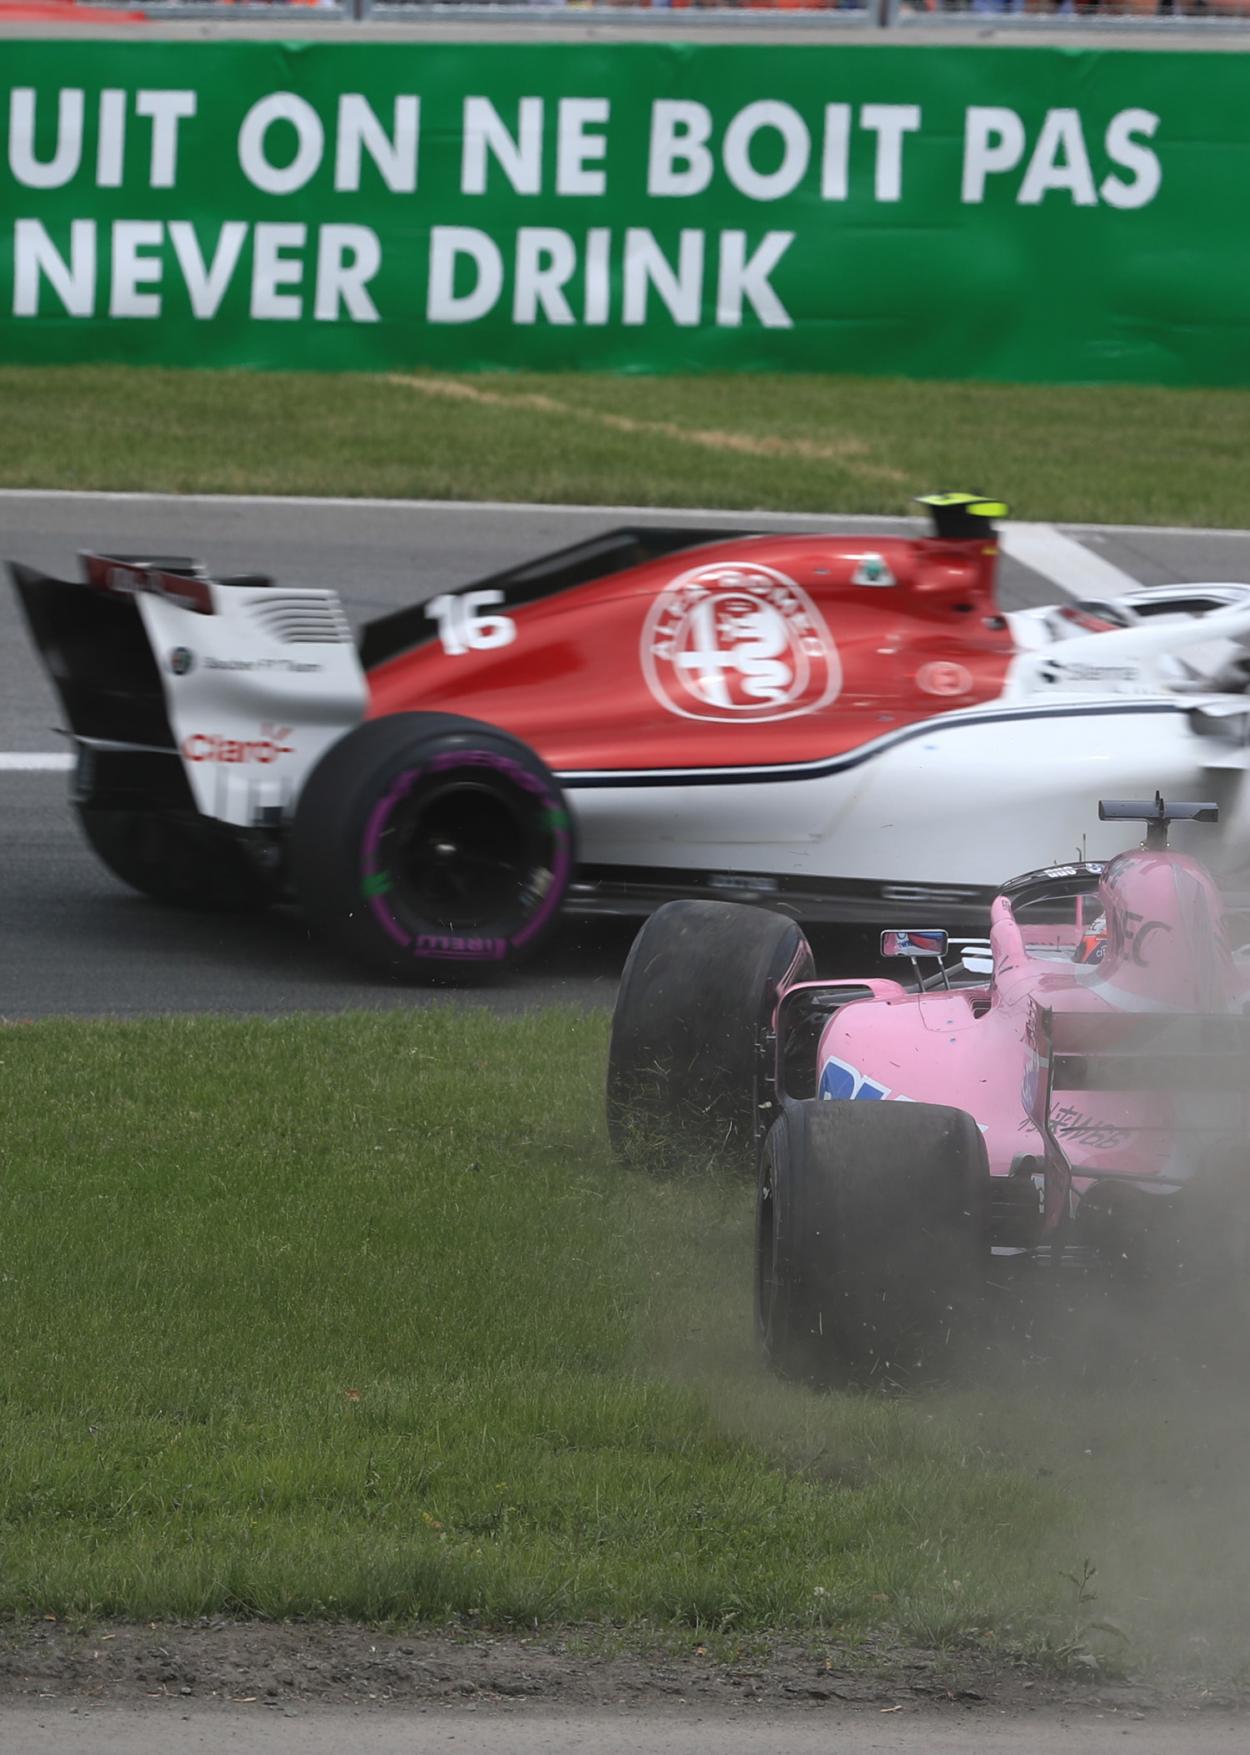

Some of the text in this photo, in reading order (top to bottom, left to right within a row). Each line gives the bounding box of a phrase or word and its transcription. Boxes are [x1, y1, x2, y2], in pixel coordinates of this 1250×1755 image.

[8, 88, 1161, 209] UIT ON NE BOIT PAS
[13, 219, 795, 328] NEVER DRINK
[424, 589, 517, 655] 16
[181, 732, 280, 764] Claro
